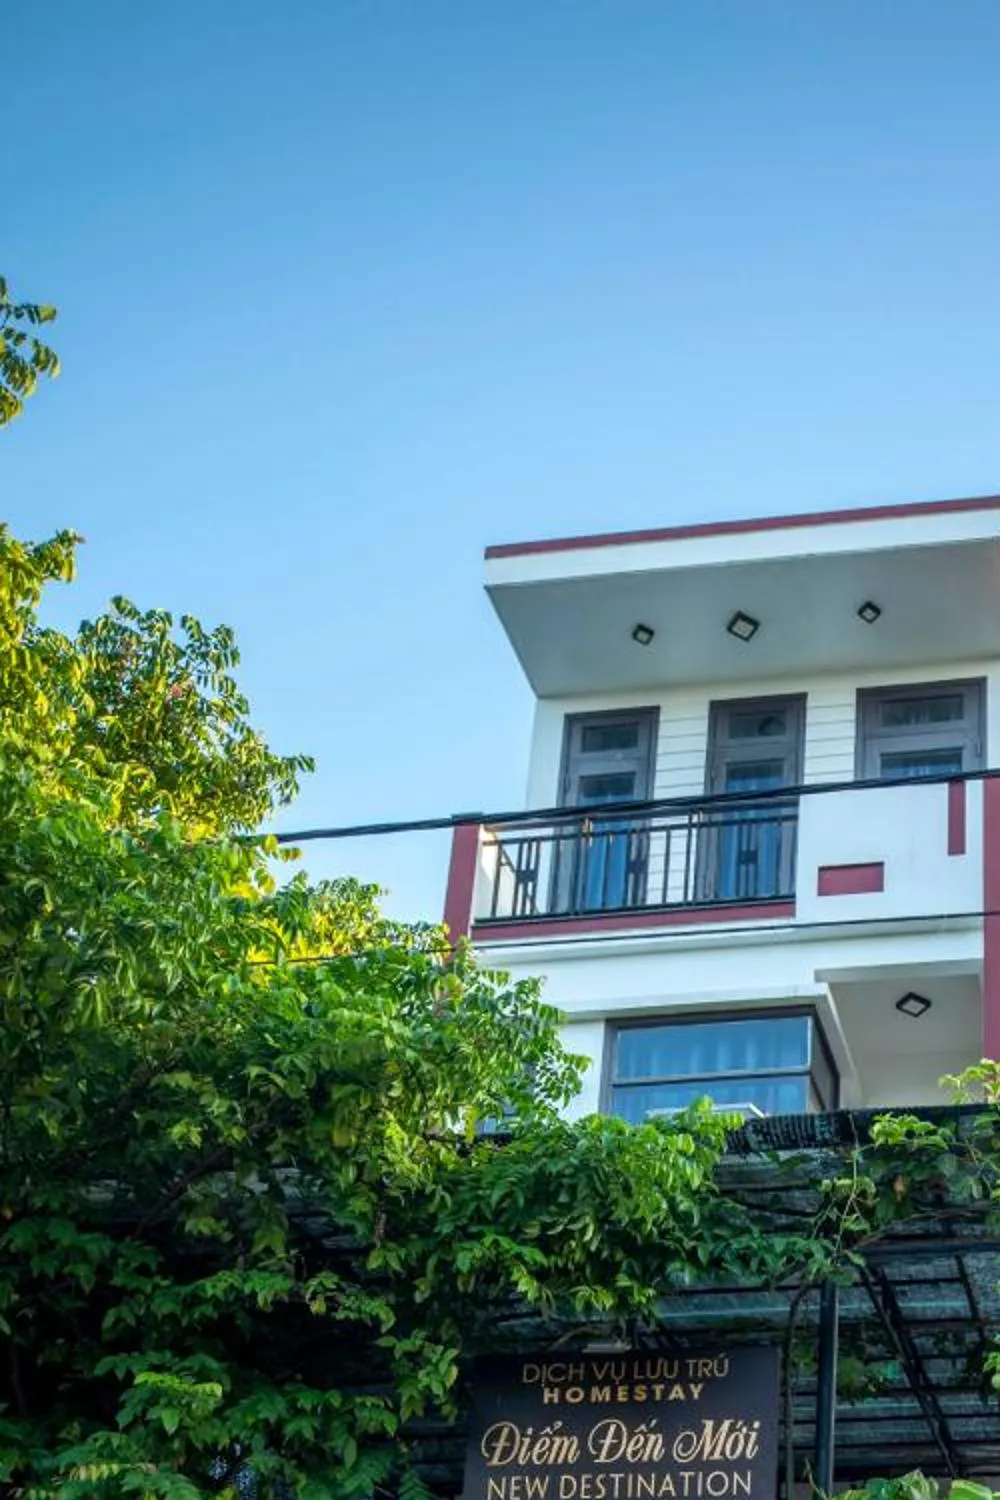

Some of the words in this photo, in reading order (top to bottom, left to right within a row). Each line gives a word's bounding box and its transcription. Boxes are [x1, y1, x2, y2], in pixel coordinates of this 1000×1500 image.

[523, 1362, 585, 1388] DỊCH
[591, 1361, 626, 1385] VỤ
[633, 1357, 680, 1380] LƯU
[685, 1353, 730, 1378] TRÚ
[543, 1383, 705, 1405] HOMESTAY
[481, 1419, 580, 1467] Điểm
[587, 1415, 665, 1464] Đến
[673, 1418, 761, 1464] Mới
[559, 1470, 752, 1500] DESTINATION
